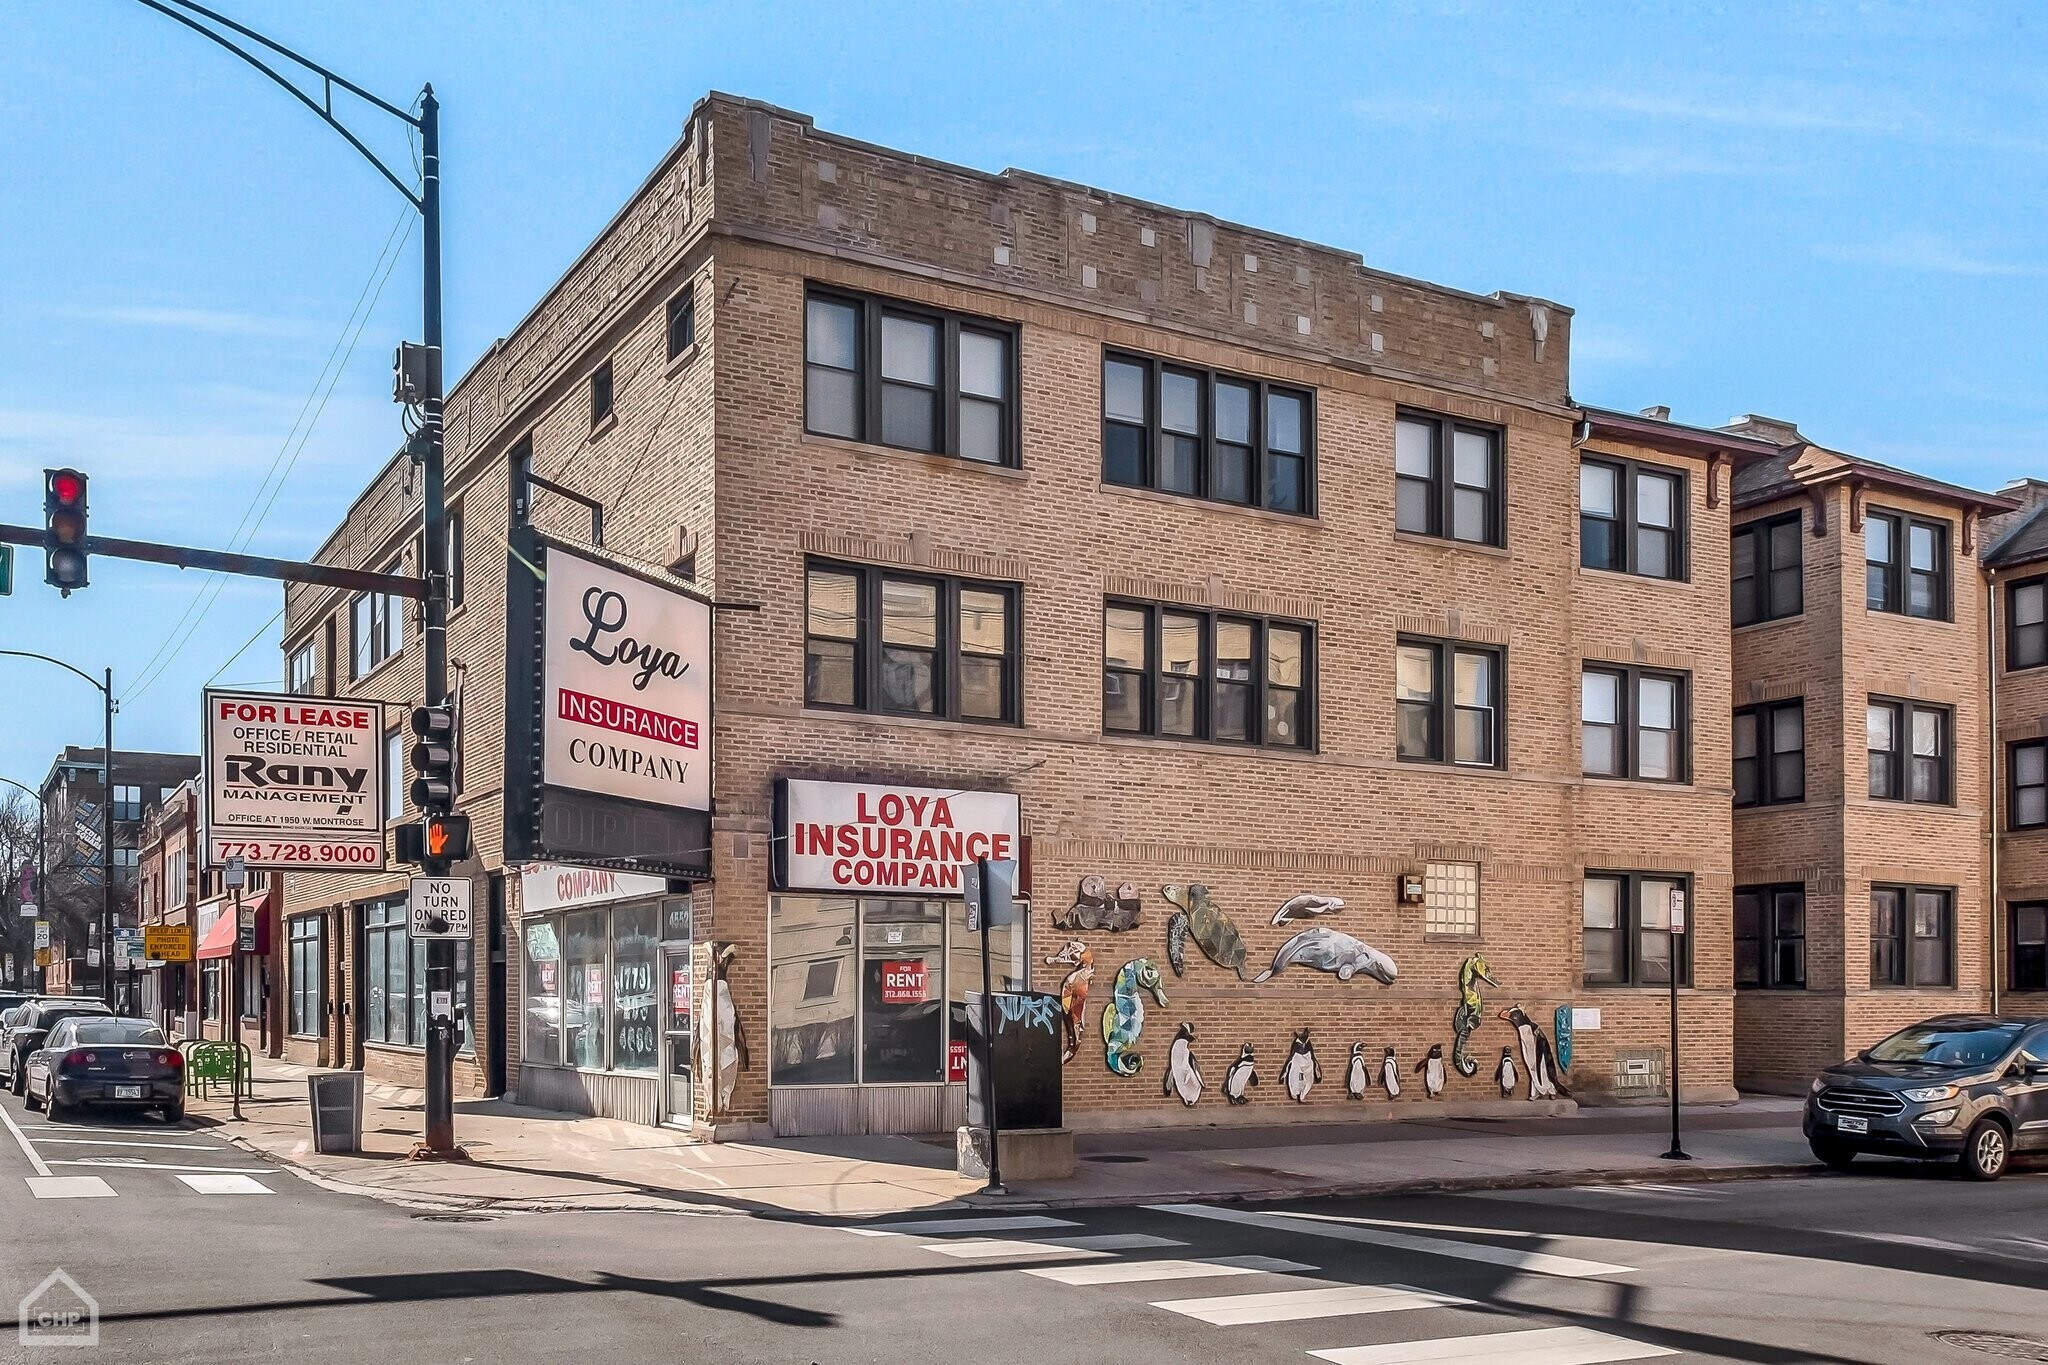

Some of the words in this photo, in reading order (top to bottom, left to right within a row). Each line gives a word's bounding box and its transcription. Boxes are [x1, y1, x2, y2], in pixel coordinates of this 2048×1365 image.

[568, 585, 690, 692] Loya
[220, 703, 277, 723] FOR
[284, 707, 369, 729] LEASE
[560, 692, 697, 747] INSURANCE
[233, 727, 291, 741] OFFICE
[294, 730, 300, 742] /
[305, 731, 358, 745] RETAIL
[244, 742, 348, 758] RESIDENTIAL
[568, 738, 689, 784] COMPANY
[224, 755, 368, 796] Rany
[223, 789, 367, 804] MANAGEMENT
[228, 813, 262, 822] OFFICE
[264, 815, 277, 823] AT
[280, 816, 300, 824] 1950
[857, 792, 955, 829] LOYA
[217, 842, 376, 863] 773.728.9000
[795, 822, 1011, 863] INSURANCE
[832, 858, 963, 888] COMPAN
[430, 882, 451, 894] NO
[557, 870, 615, 901] COMPANY
[423, 895, 458, 907] TURN
[415, 909, 432, 920] ON
[441, 909, 467, 921] RED
[449, 923, 468, 932] 7PM
[886, 973, 925, 987] RENT
